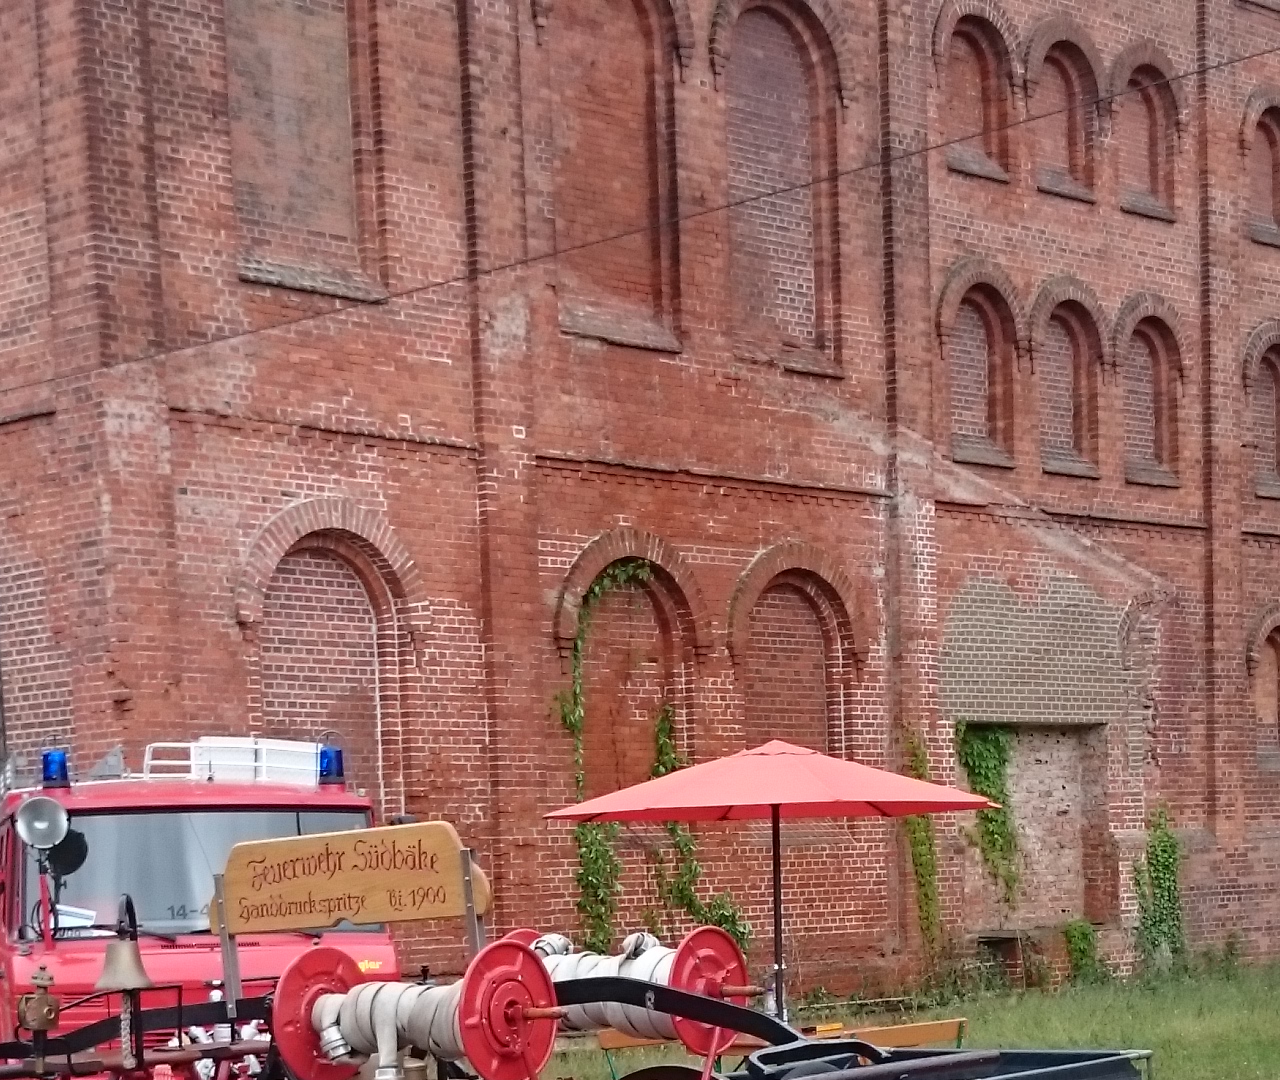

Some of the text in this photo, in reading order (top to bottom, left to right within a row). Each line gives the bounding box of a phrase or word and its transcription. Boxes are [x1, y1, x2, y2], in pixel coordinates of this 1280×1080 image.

[246, 839, 440, 891] Feuerwehr Südbäke
[238, 890, 368, 925] Handdruckspritze
